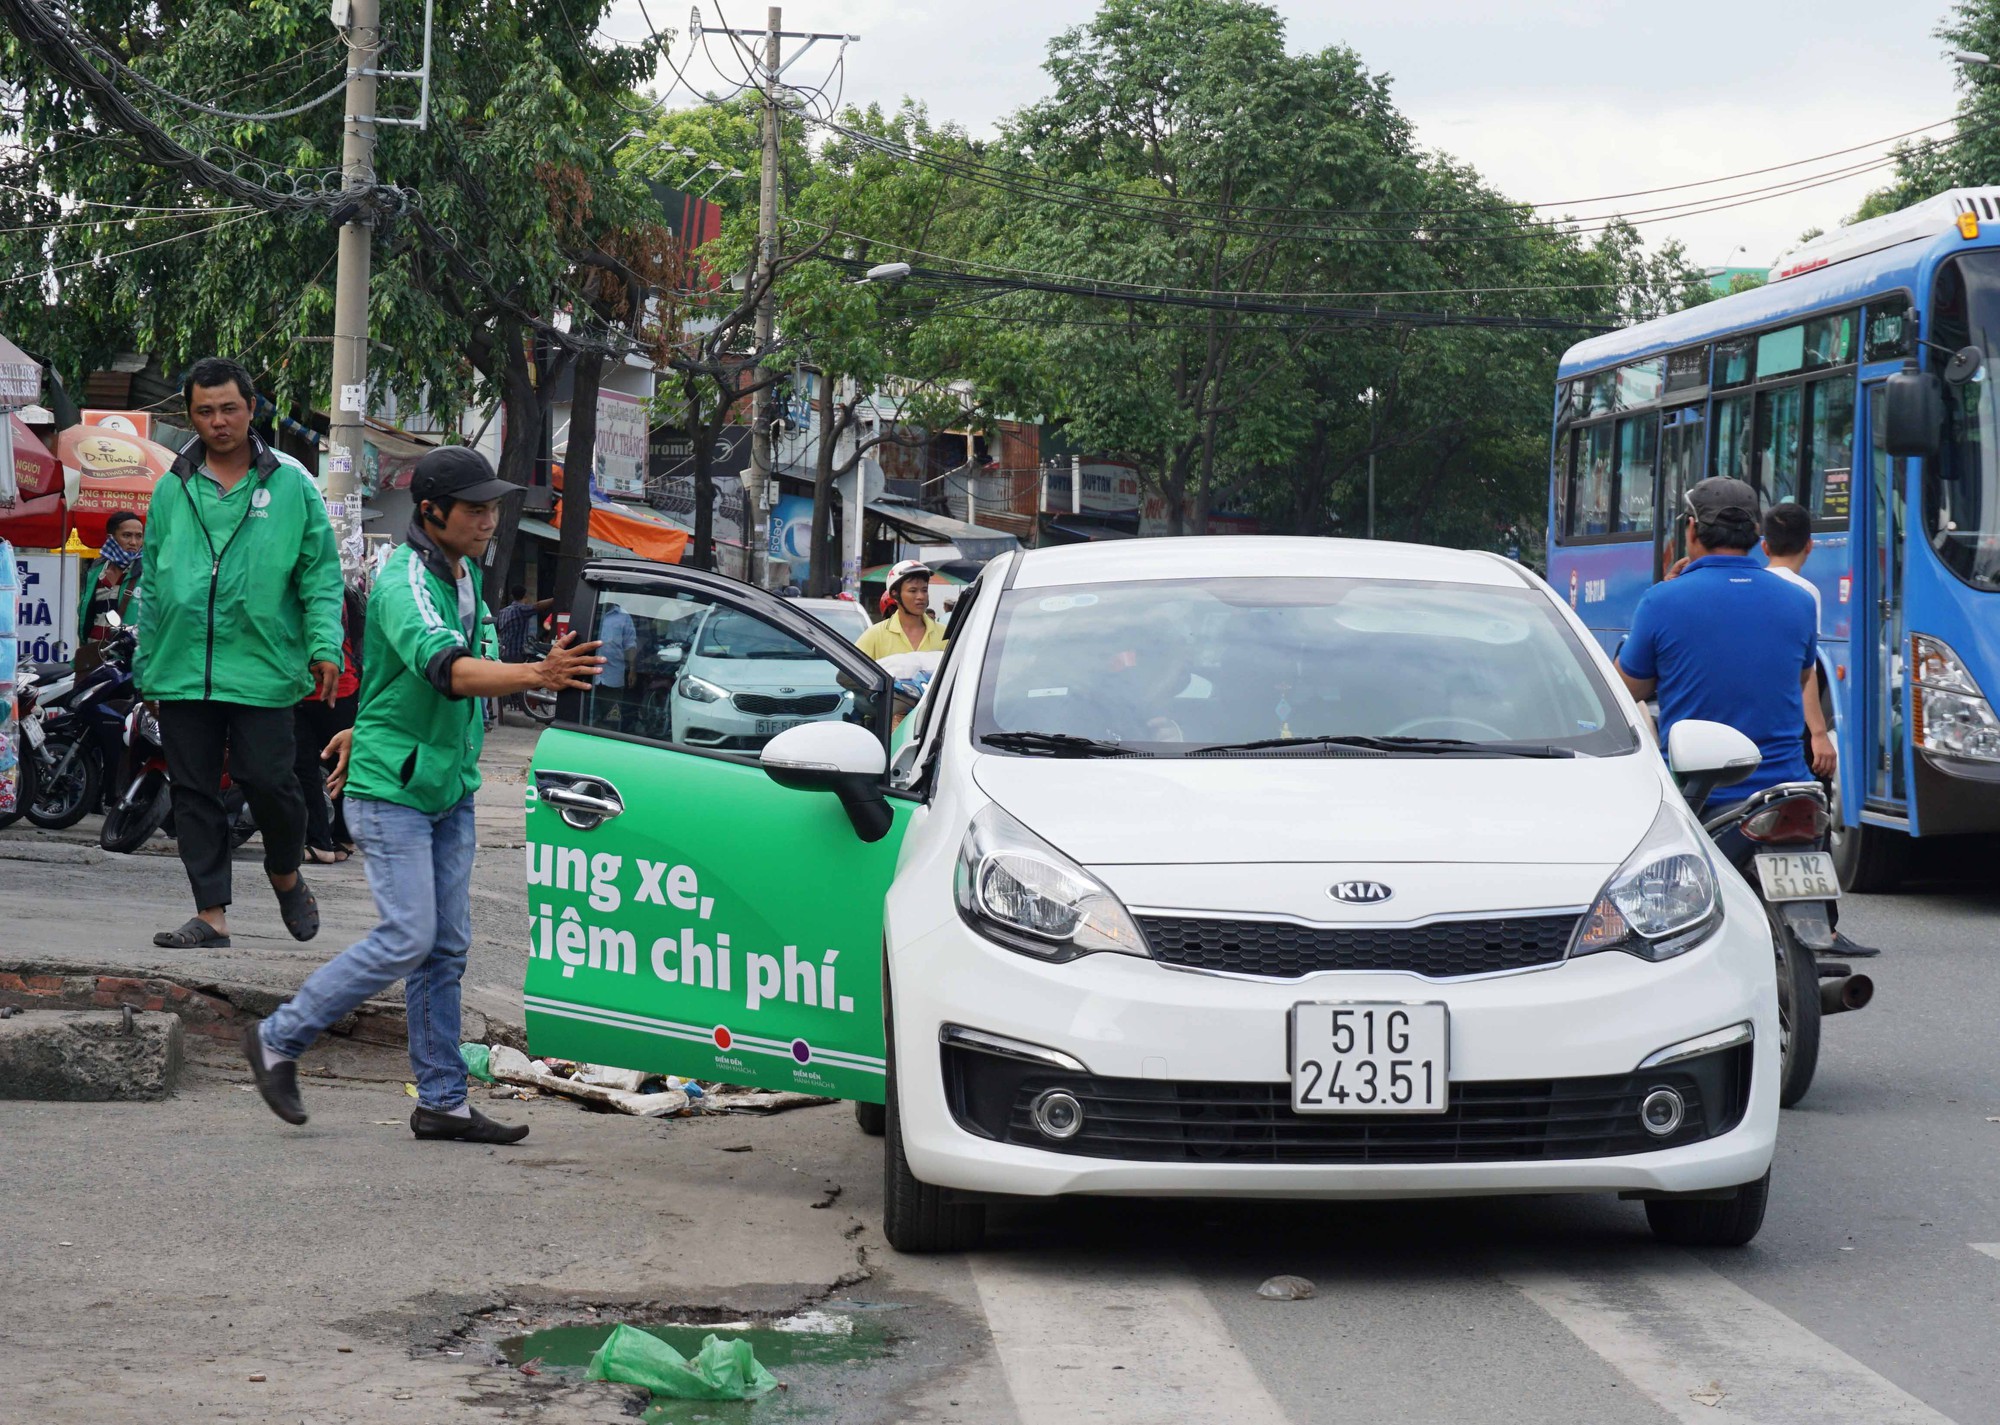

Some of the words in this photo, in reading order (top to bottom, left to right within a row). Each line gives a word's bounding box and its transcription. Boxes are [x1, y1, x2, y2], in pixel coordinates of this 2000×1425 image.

[102, 490, 135, 500] TRONG
[1768, 855, 1824, 876] 77-N2
[633, 858, 715, 920] xe,
[1337, 882, 1386, 899] KIA
[650, 927, 731, 992] chi
[745, 944, 854, 1013] phí.
[1331, 1009, 1410, 1055] 51G
[1300, 1059, 1432, 1105] 243.51
